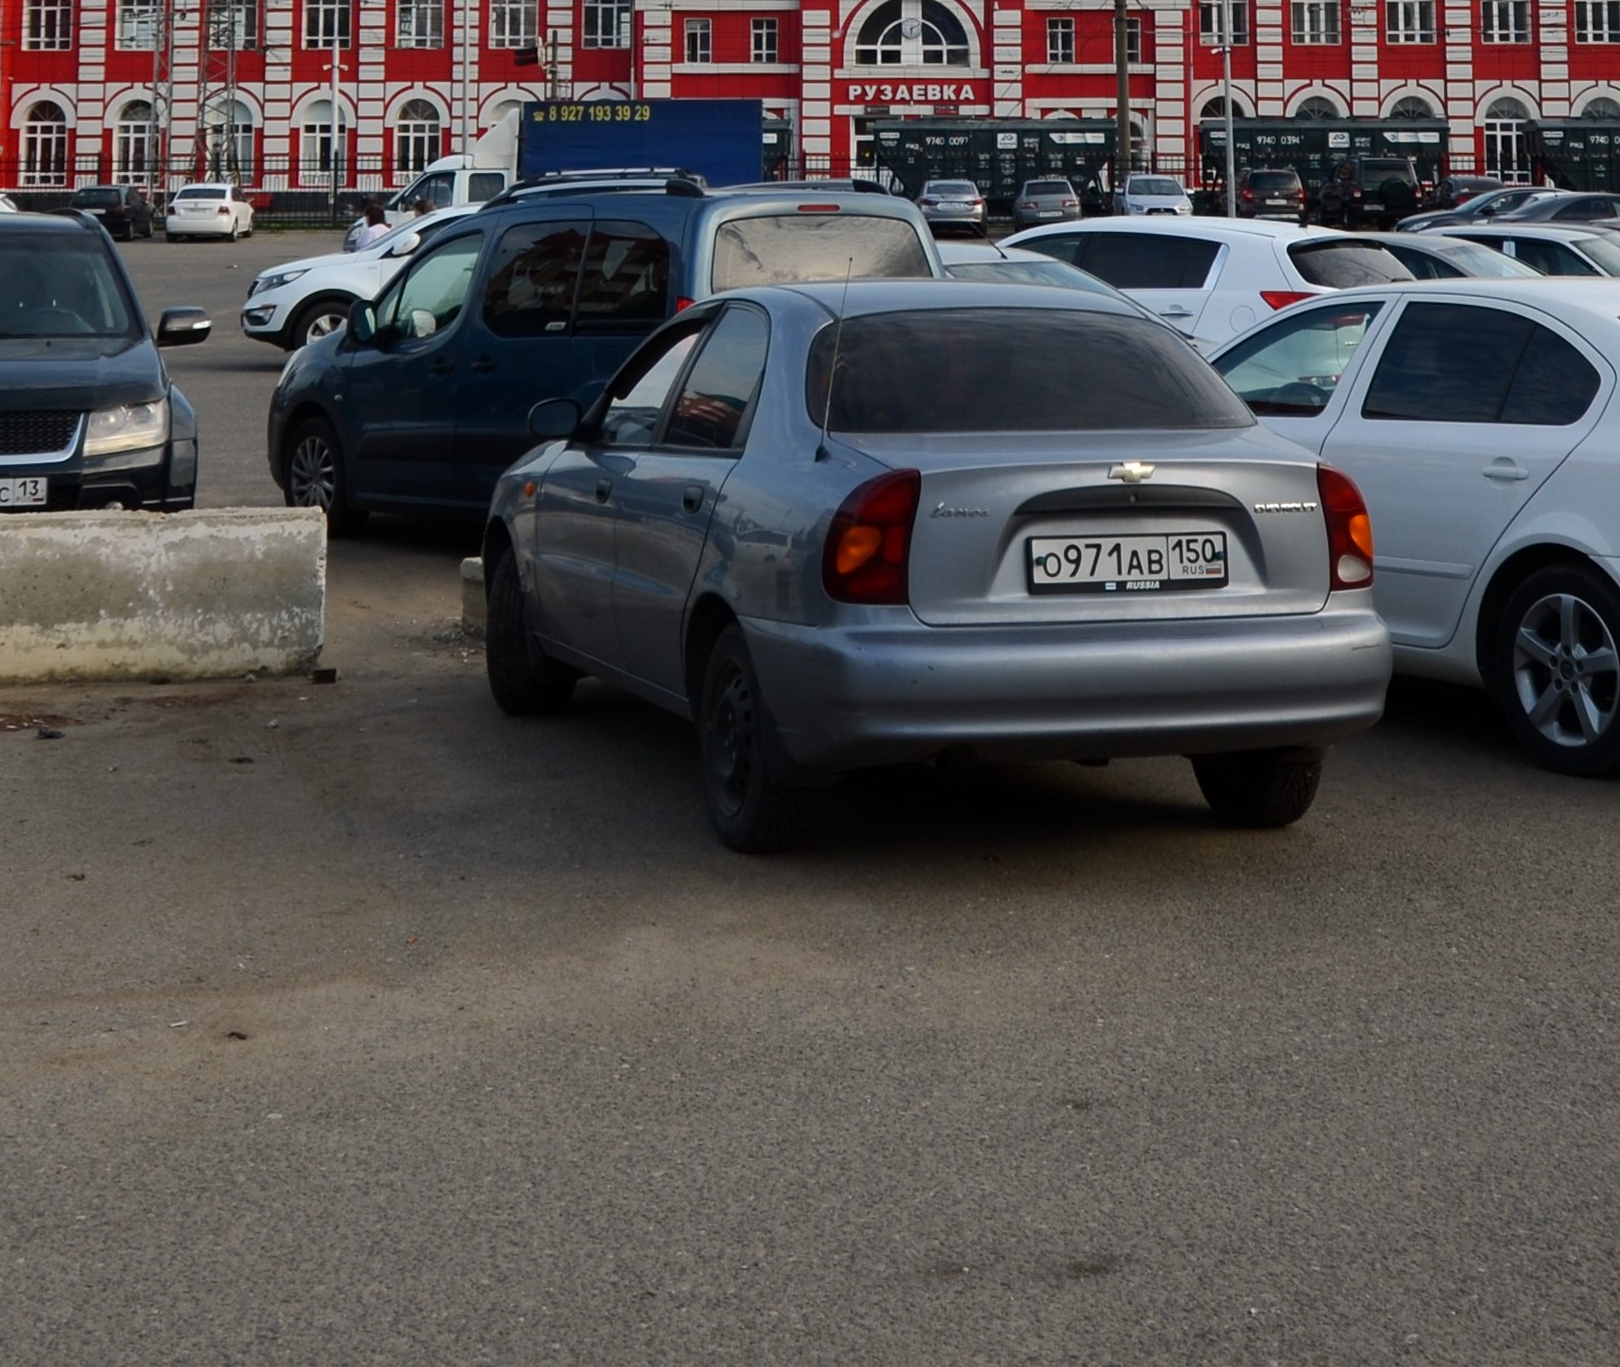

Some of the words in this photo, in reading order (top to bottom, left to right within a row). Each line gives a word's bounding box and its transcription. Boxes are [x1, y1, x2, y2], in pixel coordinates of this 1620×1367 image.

[848, 84, 975, 101] РУЗАЕВКА
[548, 105, 557, 121] 8
[561, 105, 584, 121] 927
[588, 105, 611, 121] 193
[615, 105, 631, 121] 39
[634, 105, 650, 121] 29
[926, 136, 945, 145] 9740
[1257, 135, 1276, 144] 9740
[1589, 135, 1609, 144] 9740
[18, 480, 39, 497] 13
[1043, 543, 1164, 578] О971АВ
[1171, 538, 1216, 564] 150
[1182, 565, 1205, 575] RUS
[1126, 581, 1160, 590] RUSSIA
